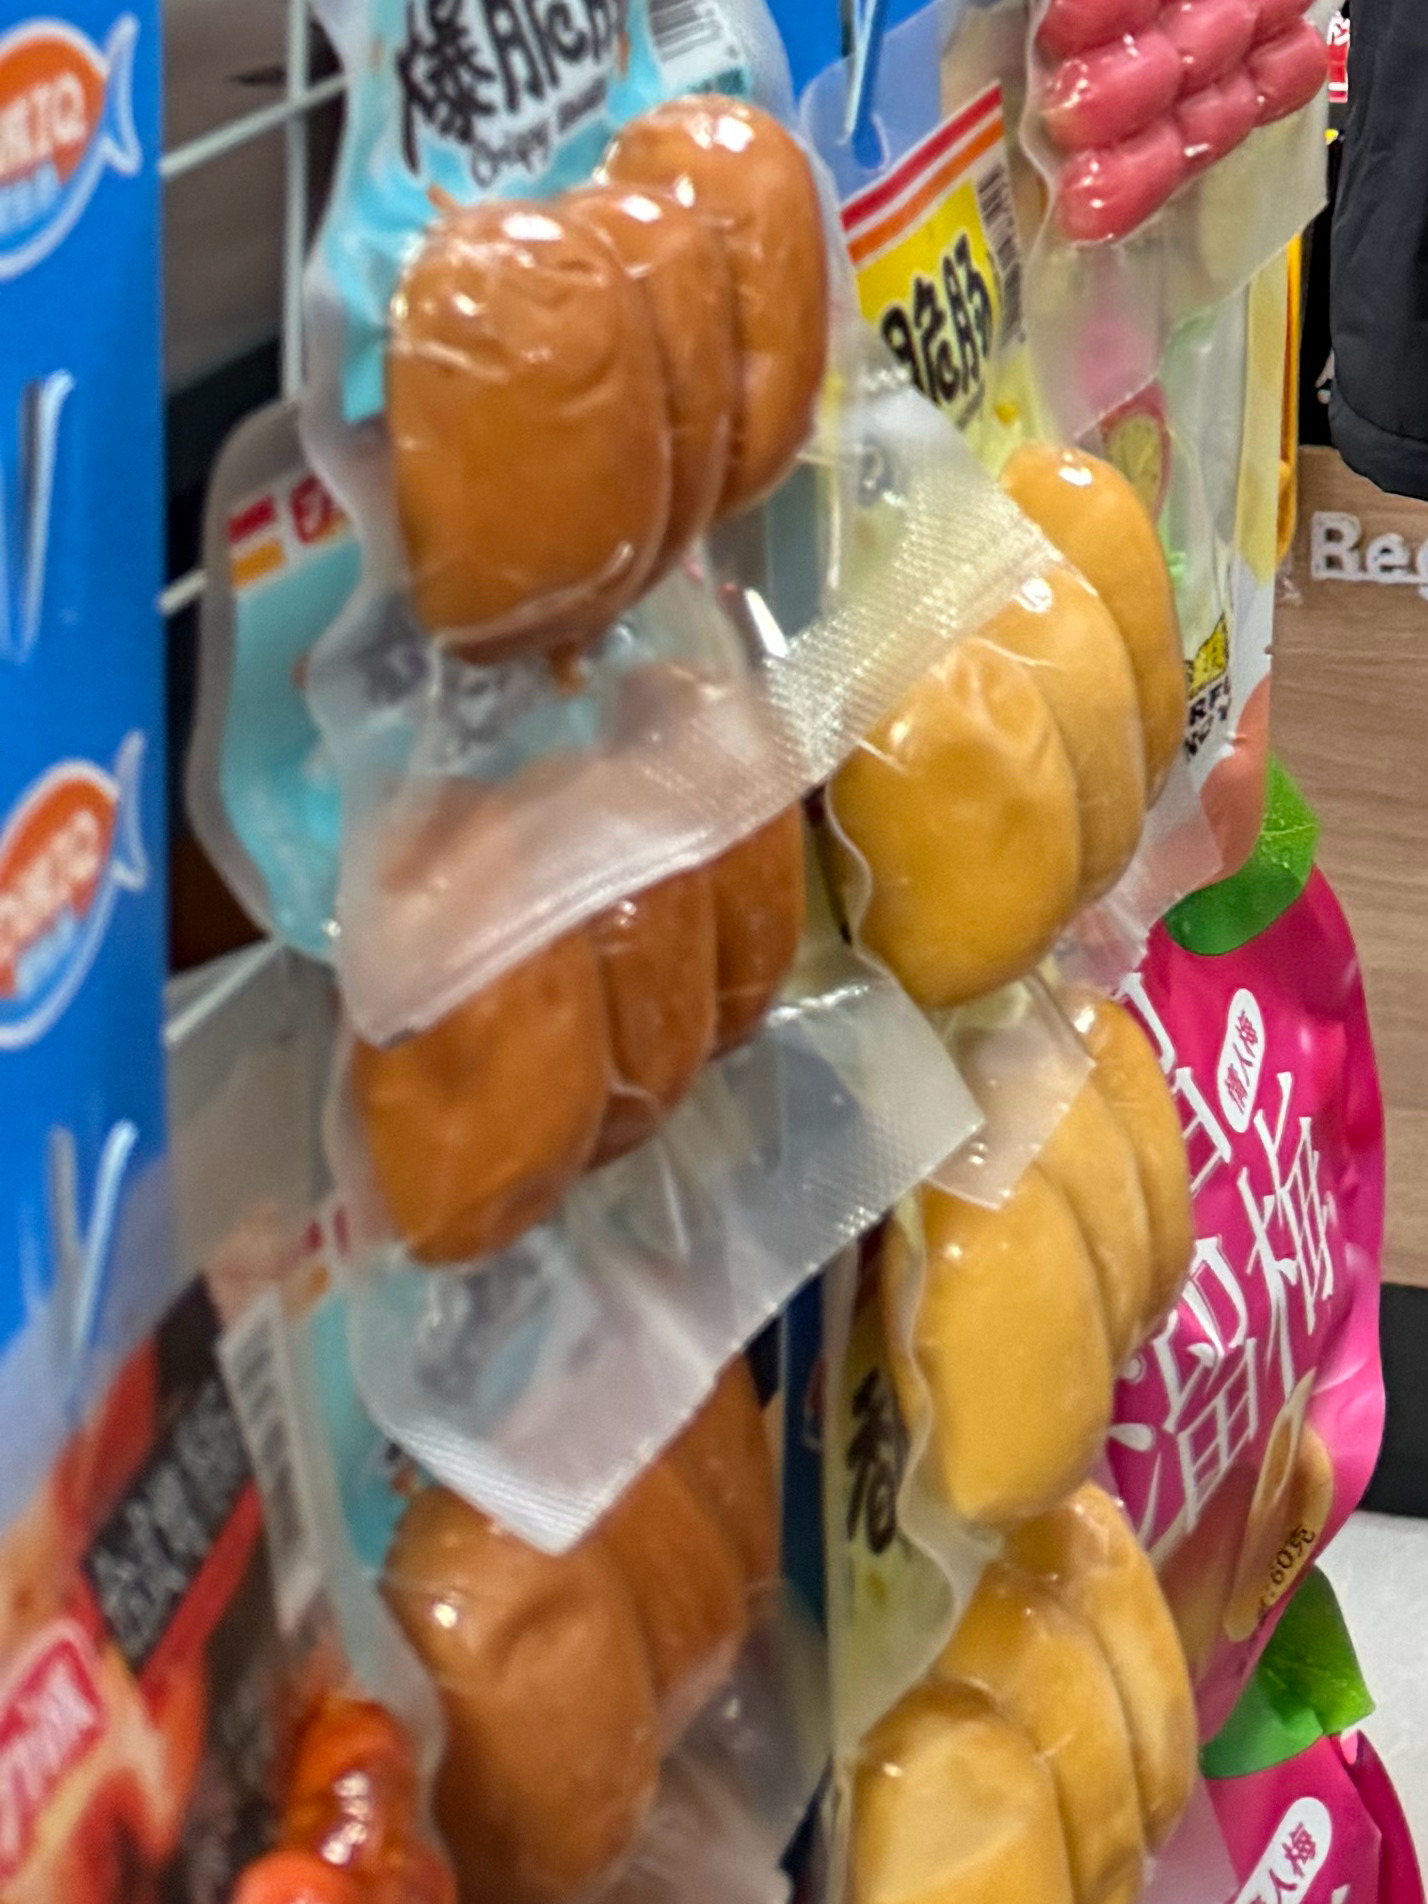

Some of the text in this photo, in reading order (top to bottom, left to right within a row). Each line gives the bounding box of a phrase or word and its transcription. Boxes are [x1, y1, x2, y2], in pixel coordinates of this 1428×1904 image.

[1225, 1009, 1259, 1116] 情人梅
[1250, 1822, 1317, 1904] 人梅
